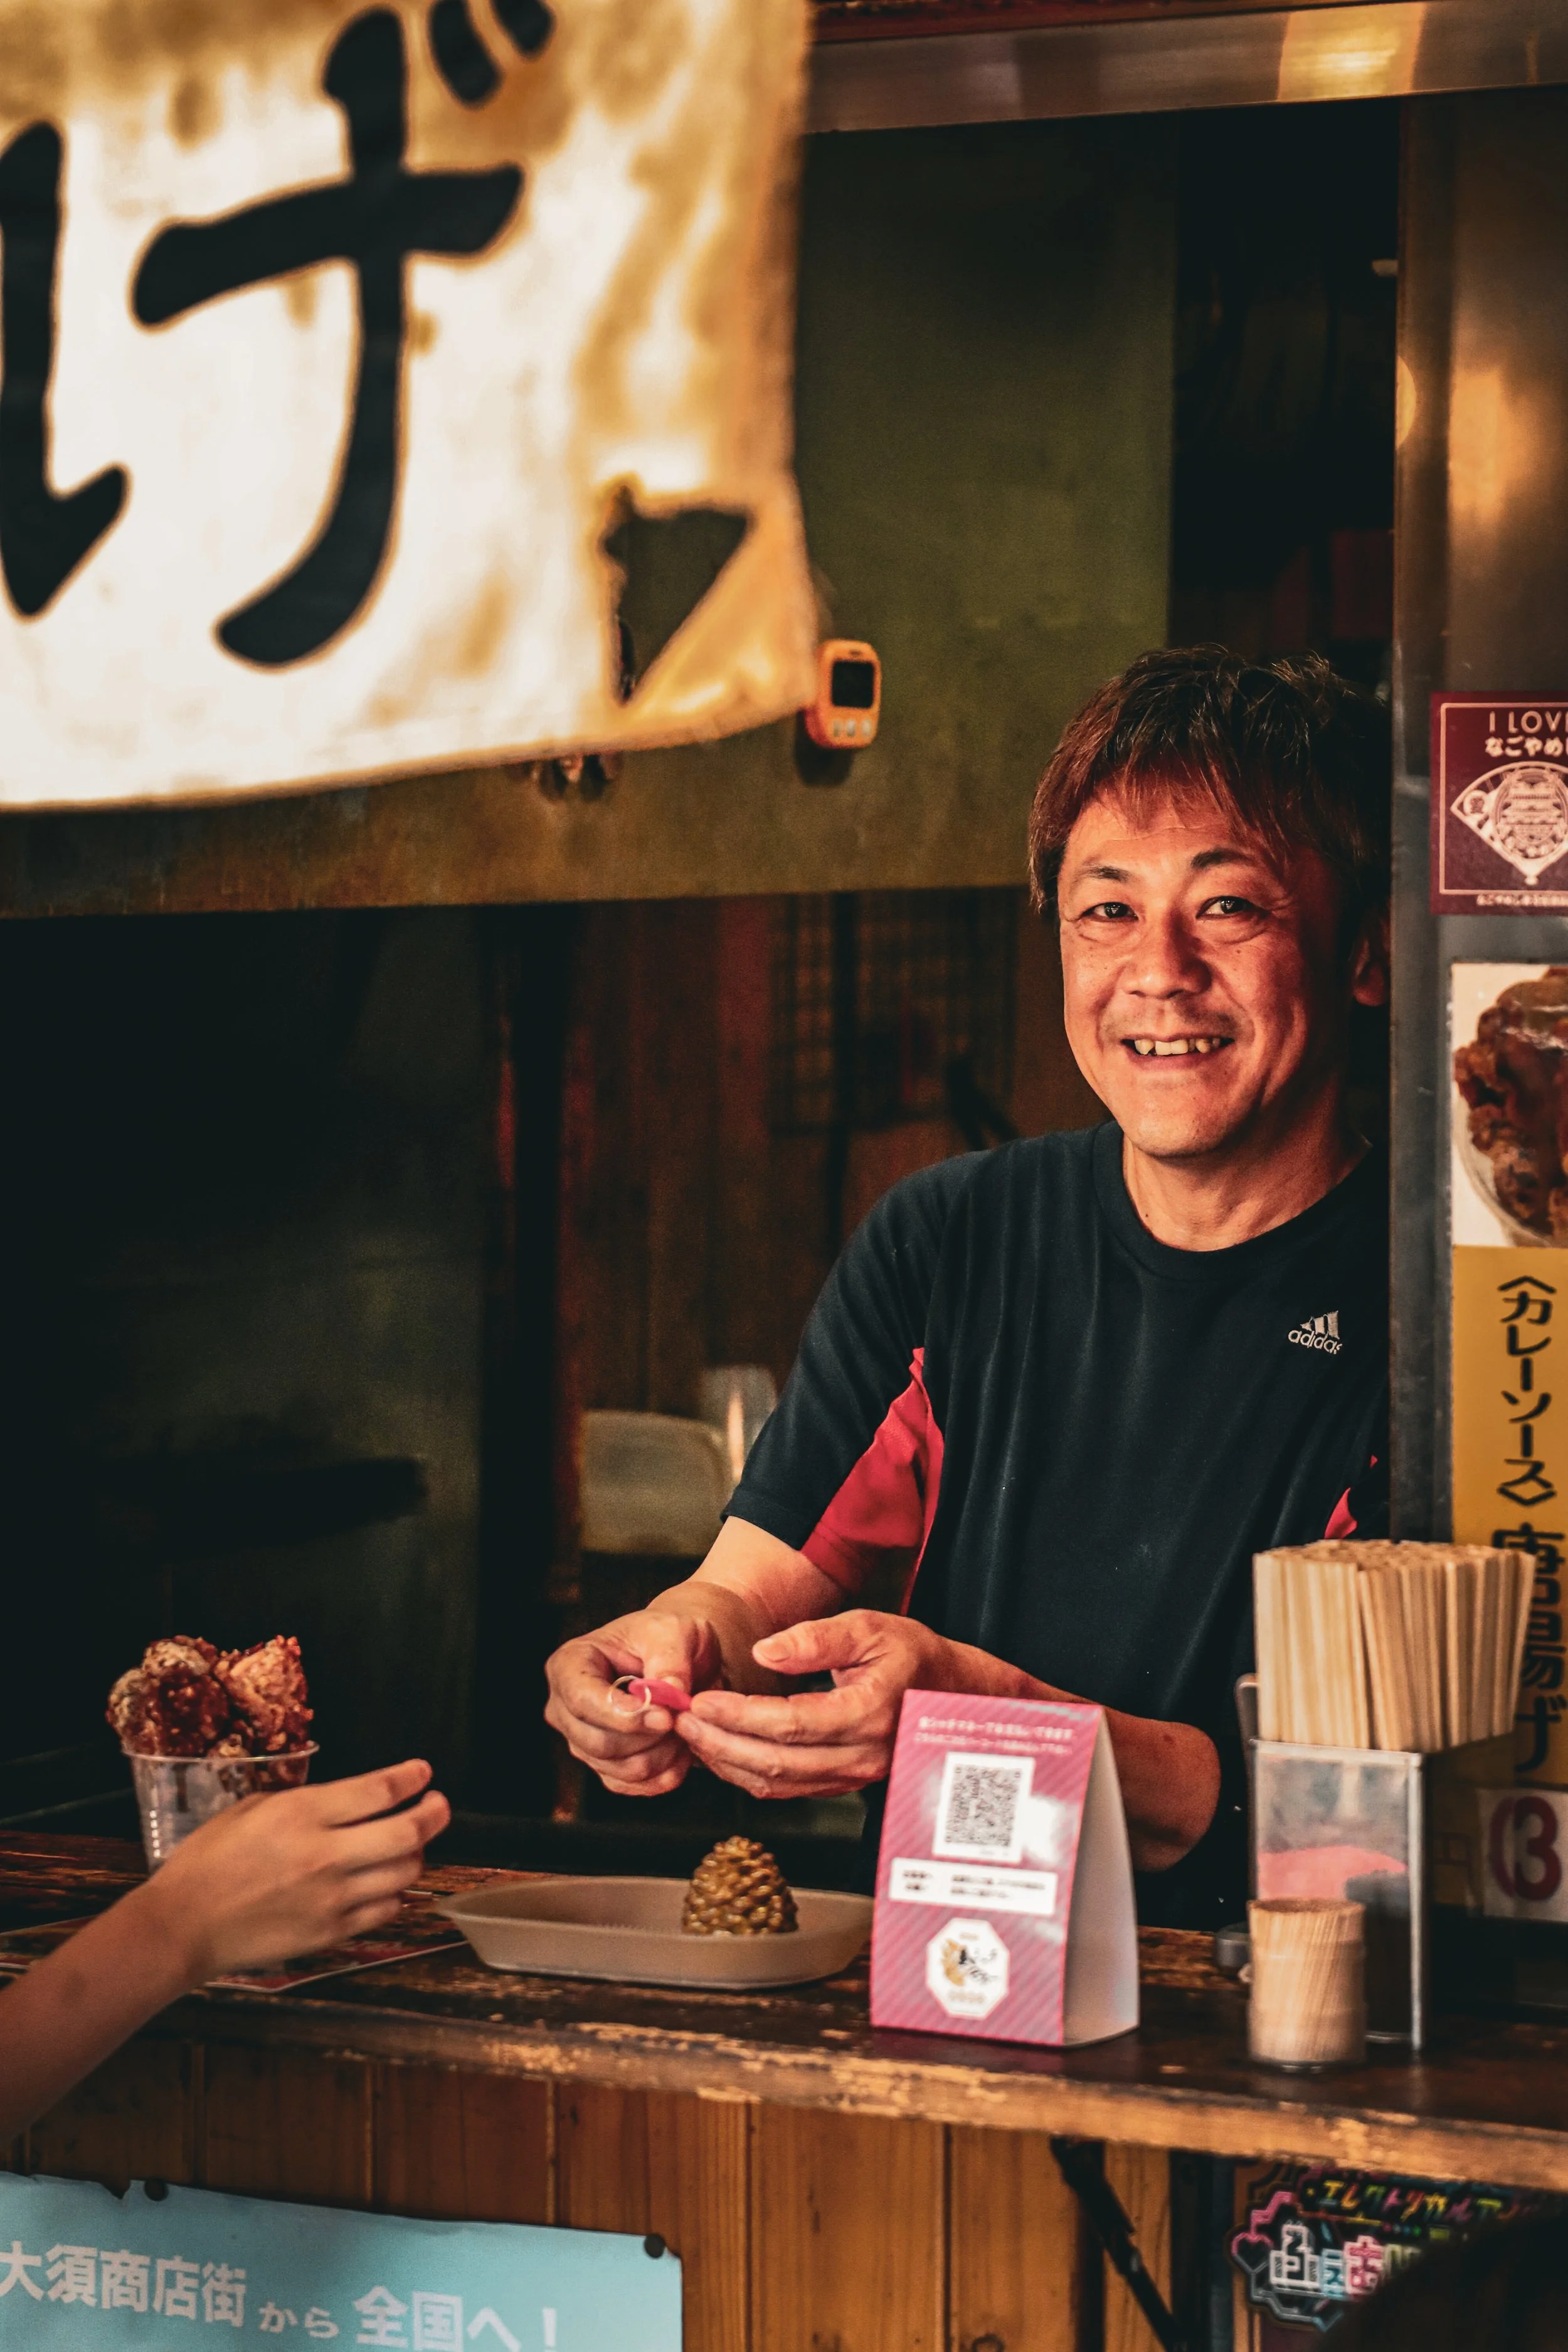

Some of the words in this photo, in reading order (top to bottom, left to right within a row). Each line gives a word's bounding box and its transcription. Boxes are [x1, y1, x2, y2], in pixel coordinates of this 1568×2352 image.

[0, 0, 555, 671] げ
[1490, 710, 1496, 733] I
[1508, 710, 1568, 734] LOV
[1485, 735, 1568, 757] なごやめ
[1288, 1330, 1343, 1355] adidas
